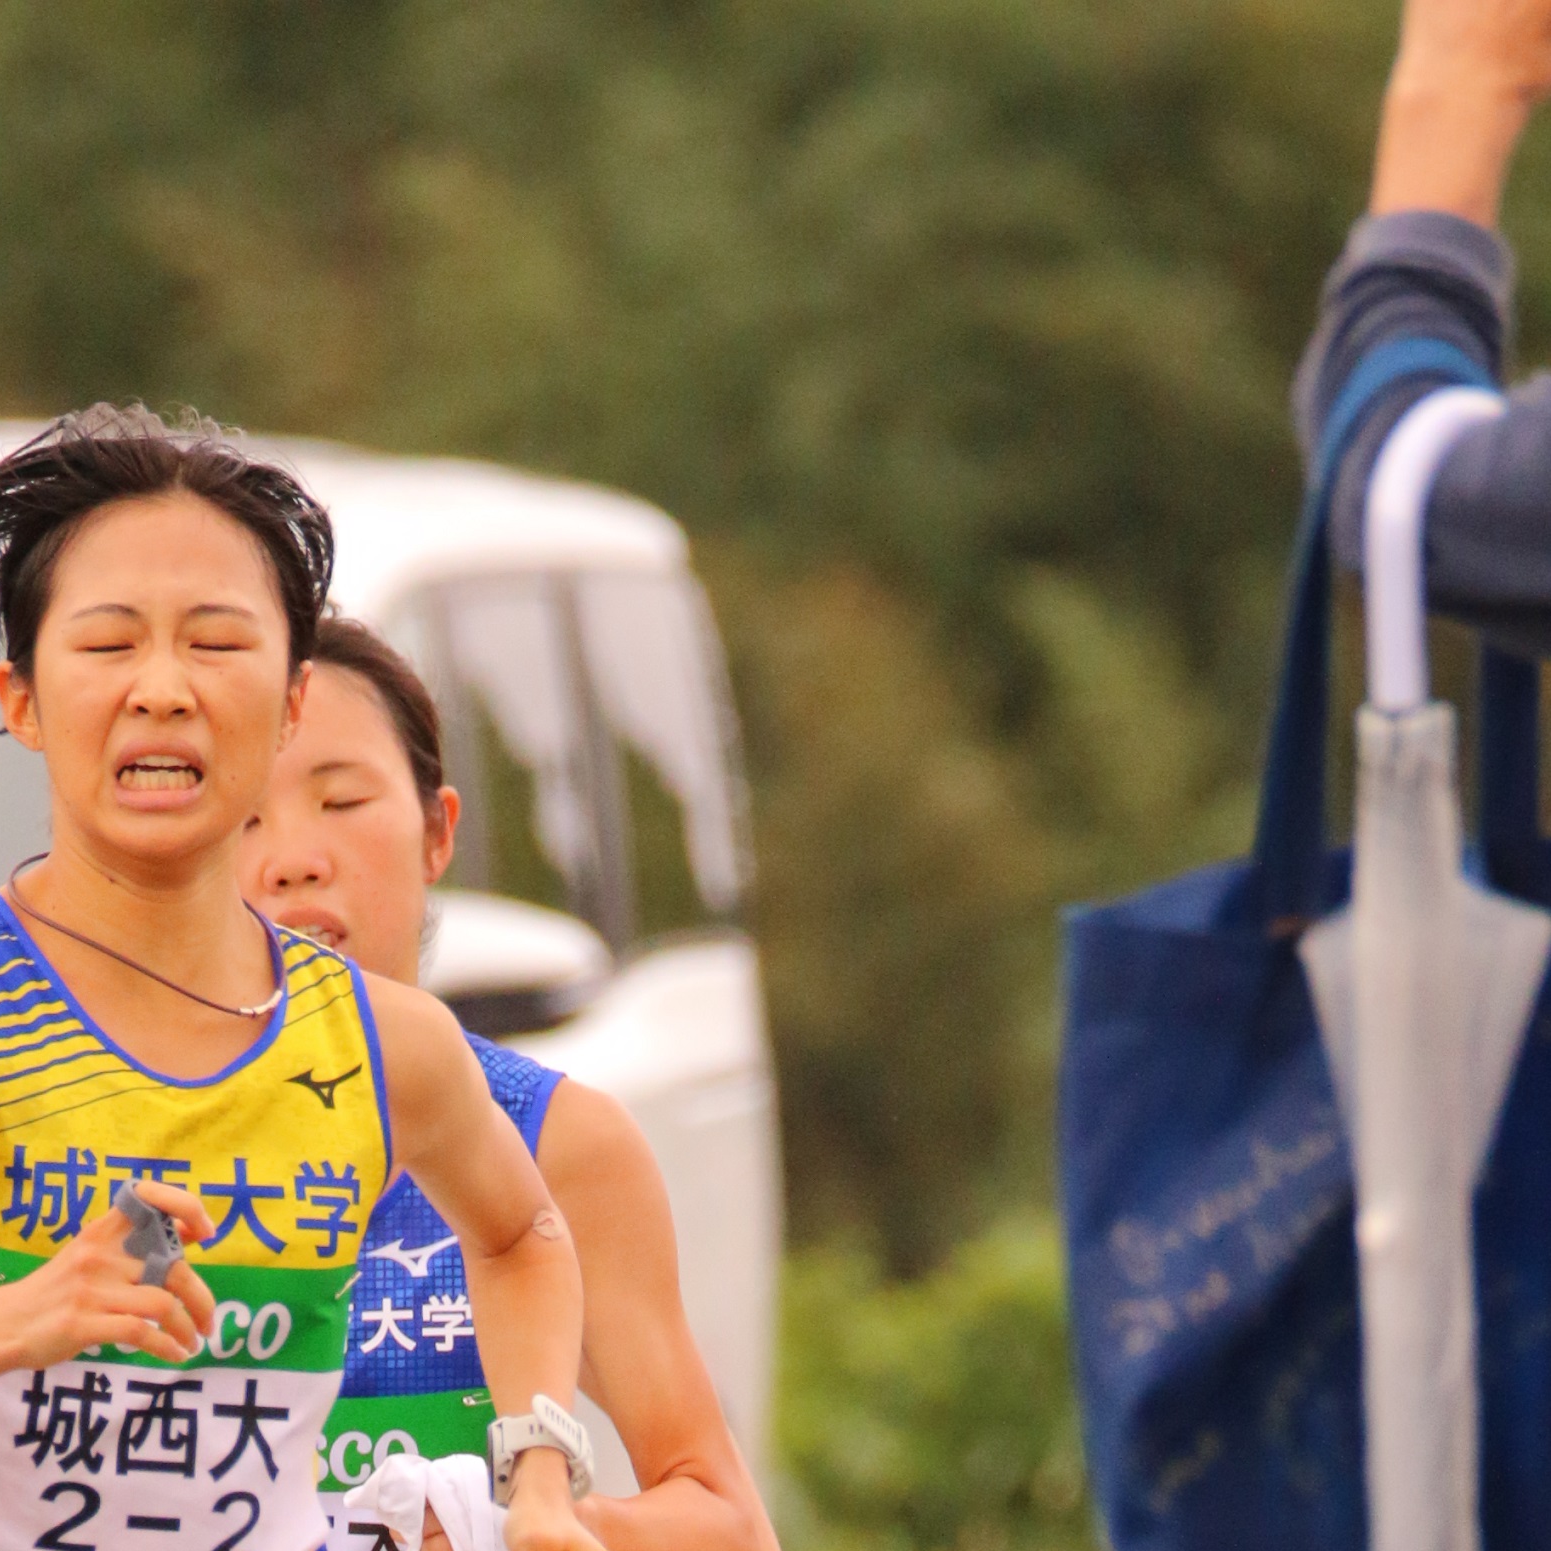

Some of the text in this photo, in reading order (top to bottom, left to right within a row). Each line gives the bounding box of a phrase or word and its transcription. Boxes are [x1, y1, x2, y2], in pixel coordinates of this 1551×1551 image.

[343, 1294, 475, 1354] 大学
[13, 1369, 290, 1482] 城西大
